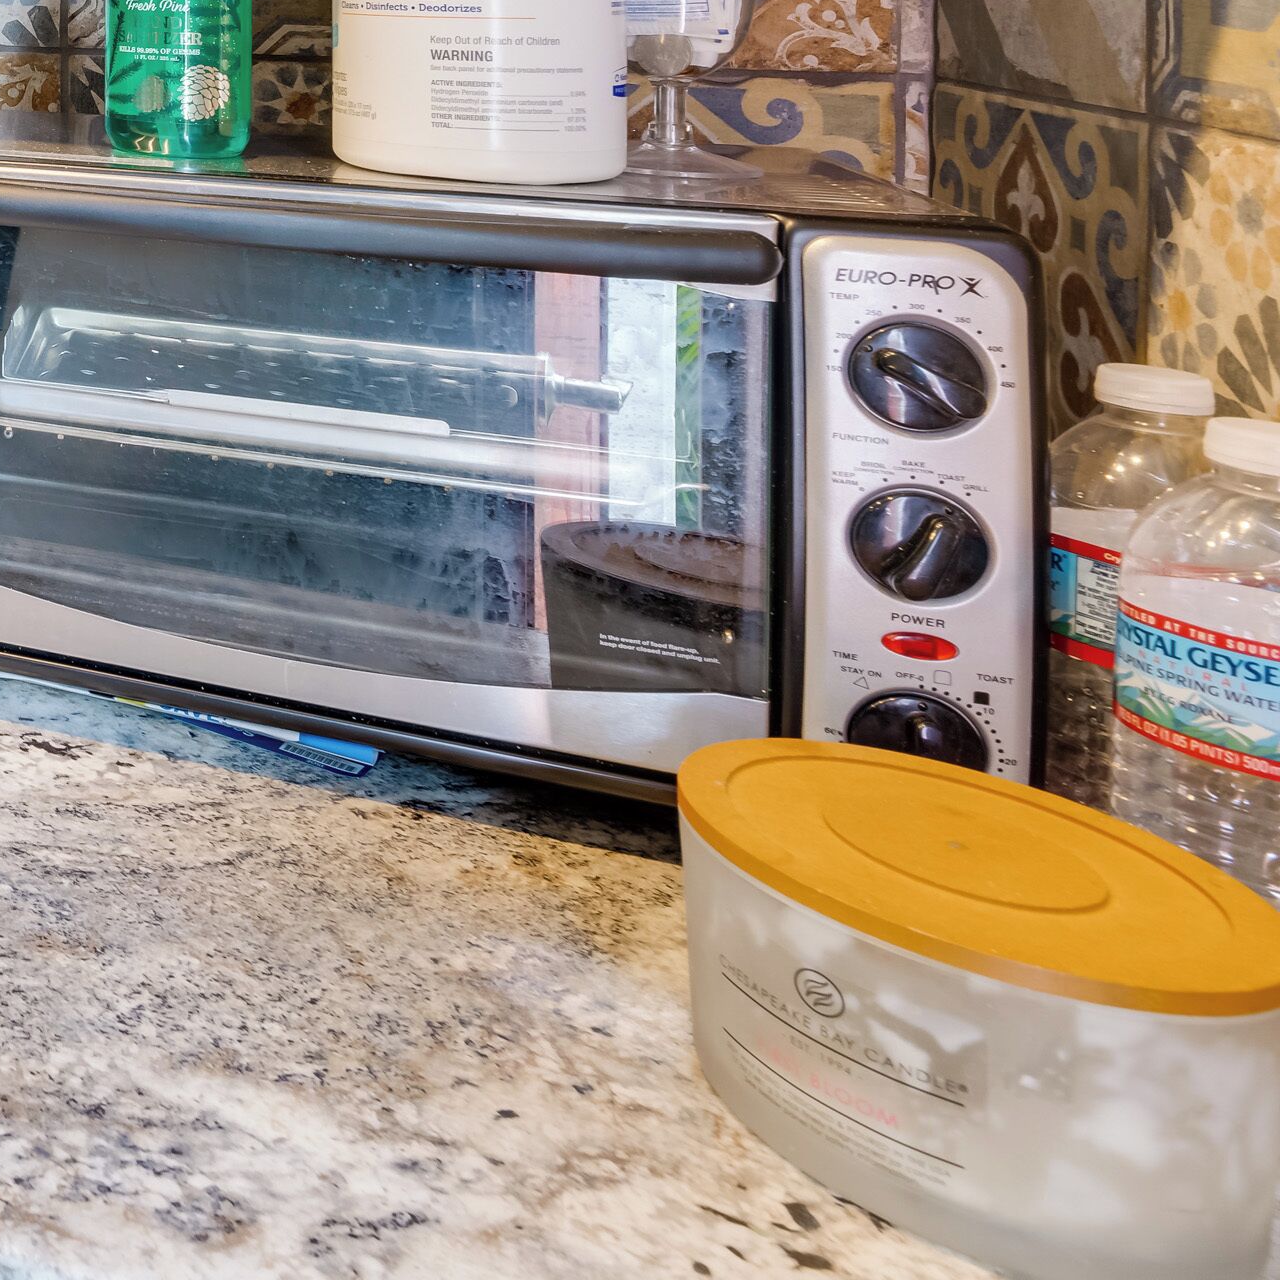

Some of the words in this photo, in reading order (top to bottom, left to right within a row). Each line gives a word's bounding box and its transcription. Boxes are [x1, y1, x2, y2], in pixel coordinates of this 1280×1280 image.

[126, 0, 157, 11] Fresh
[342, 1, 359, 9] Cleans
[366, 2, 408, 11] Disinfects
[419, 3, 482, 13] Deodorizes
[430, 35, 451, 45] Keep
[455, 36, 470, 45] Out
[473, 36, 482, 44] of
[515, 37, 524, 45] of
[526, 37, 560, 46] Children
[430, 49, 493, 62] WARNING
[835, 268, 955, 295] EURO-PRO
[830, 292, 859, 301] TEMP
[832, 433, 889, 445] FUNCTION
[893, 466, 934, 474] CONVECTION
[902, 460, 925, 468] BAKE
[938, 474, 966, 482] TOAST
[963, 484, 989, 493] GRILL
[891, 612, 946, 629] POWER
[1164, 621, 1181, 633] AT
[1188, 628, 1216, 645] THE
[620, 637, 640, 645] event
[650, 641, 667, 649] food
[600, 640, 617, 648] keep
[636, 646, 660, 654] closed
[677, 652, 703, 662] unplug
[832, 651, 858, 661] TIME
[840, 666, 864, 675] STAY
[868, 670, 882, 678] ON
[977, 673, 1015, 685] TOAST
[1157, 665, 1220, 697] SPRING
[983, 707, 995, 715] 10
[1180, 700, 1234, 724] ROXANE
[1190, 739, 1239, 764] PINTS)
[720, 954, 812, 1030] CHESAPEAKE
[820, 1024, 855, 1050] BAY
[810, 1073, 898, 1128] BLOOM
